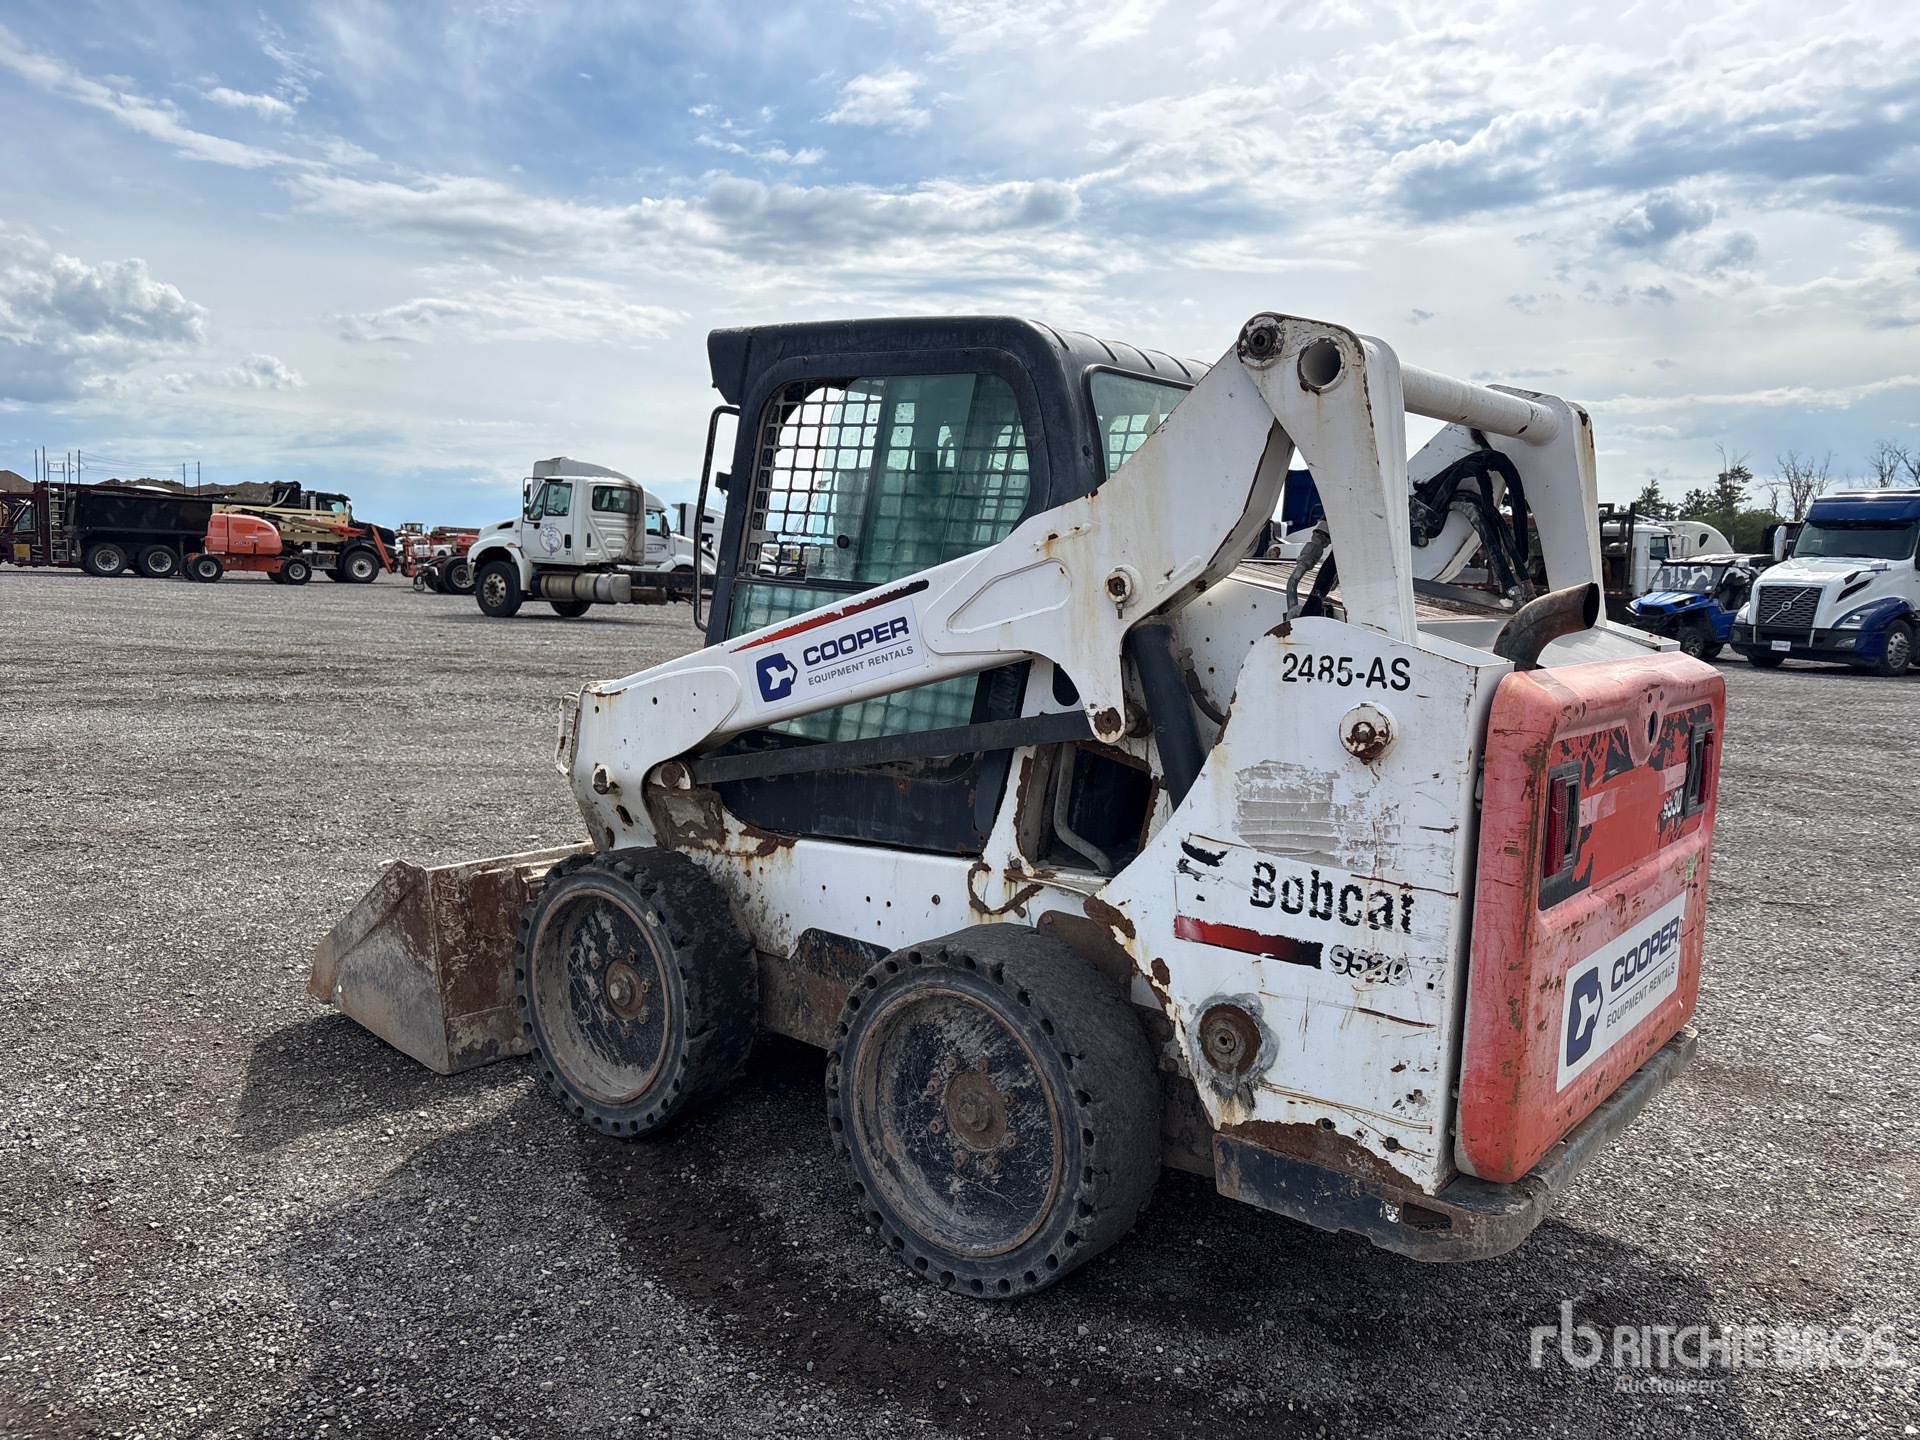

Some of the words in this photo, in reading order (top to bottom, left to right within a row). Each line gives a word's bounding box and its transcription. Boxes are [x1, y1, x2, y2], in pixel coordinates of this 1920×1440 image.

[803, 616, 909, 666] COOPER
[808, 661, 865, 686] EQUIPMENT
[868, 646, 914, 667] RENTALS
[1282, 653, 1411, 691] 2485-AS
[1250, 861, 1415, 934] Bobcat
[1611, 916, 1680, 992] COOPER
[1607, 984, 1648, 1028] EQUIPMENT
[1649, 961, 1675, 994] RENTALS
